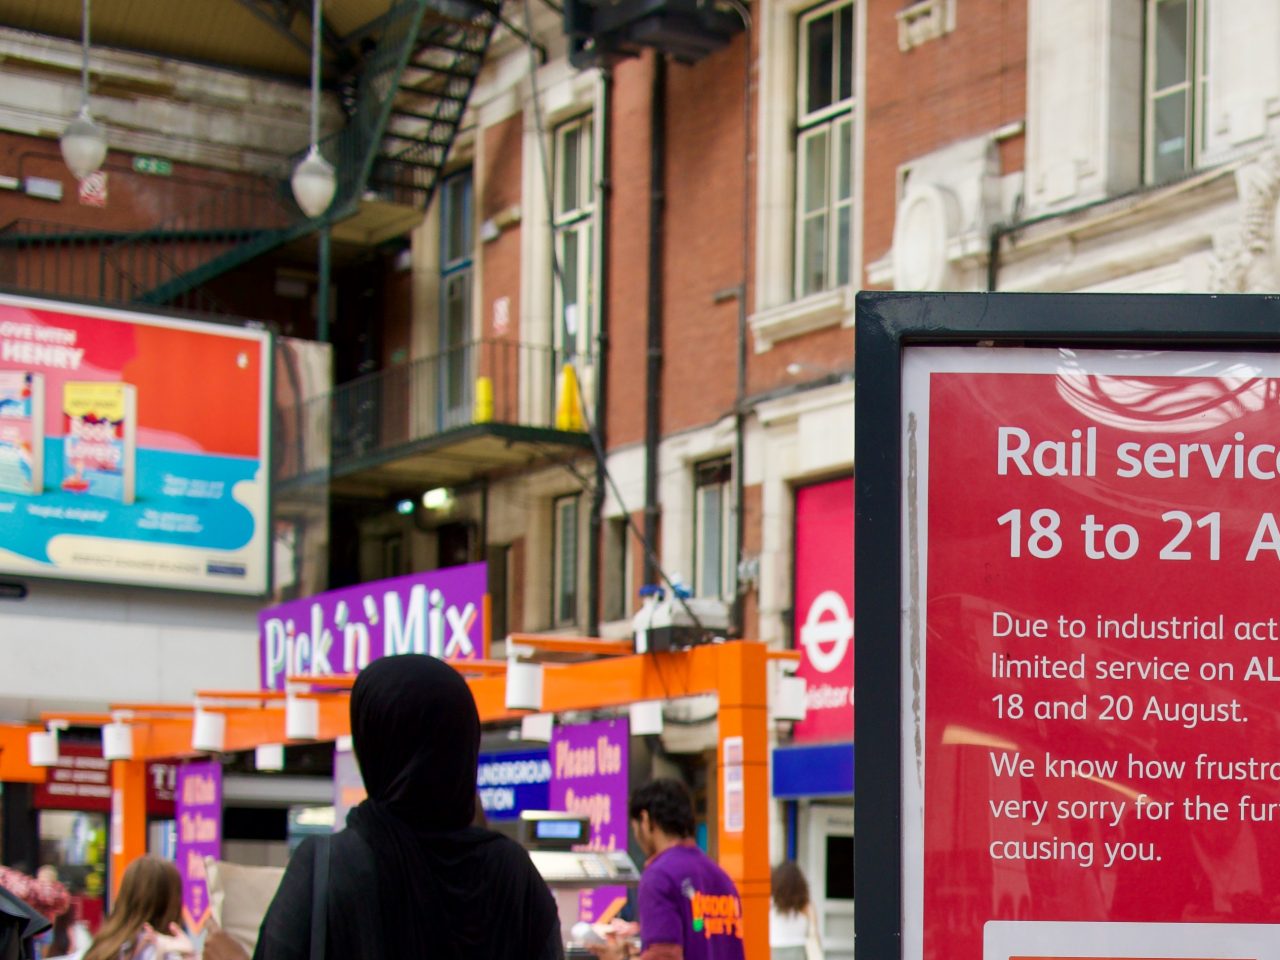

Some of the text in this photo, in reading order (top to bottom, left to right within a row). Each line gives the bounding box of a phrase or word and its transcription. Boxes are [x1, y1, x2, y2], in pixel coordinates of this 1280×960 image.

[0, 321, 32, 341] OVE
[998, 427, 1096, 476] Rail
[998, 509, 1062, 558] 18
[1081, 515, 1139, 560] to
[1160, 511, 1220, 560] 21
[993, 612, 1048, 637] Due
[1058, 616, 1085, 638] to
[1098, 614, 1223, 639] industrial
[992, 652, 1085, 678] limited
[1096, 657, 1189, 680] service
[1200, 663, 1233, 680] on
[992, 694, 1247, 728] 18 and 20 August.
[477, 759, 552, 786] UNDERGROUN
[990, 752, 1034, 777] We
[1045, 752, 1118, 779] know
[1129, 753, 1185, 778] how
[989, 800, 1048, 825] very
[1058, 801, 1125, 826] sorry
[1136, 794, 1174, 820] for
[1183, 795, 1228, 820] the
[990, 837, 1161, 867] causing you.
